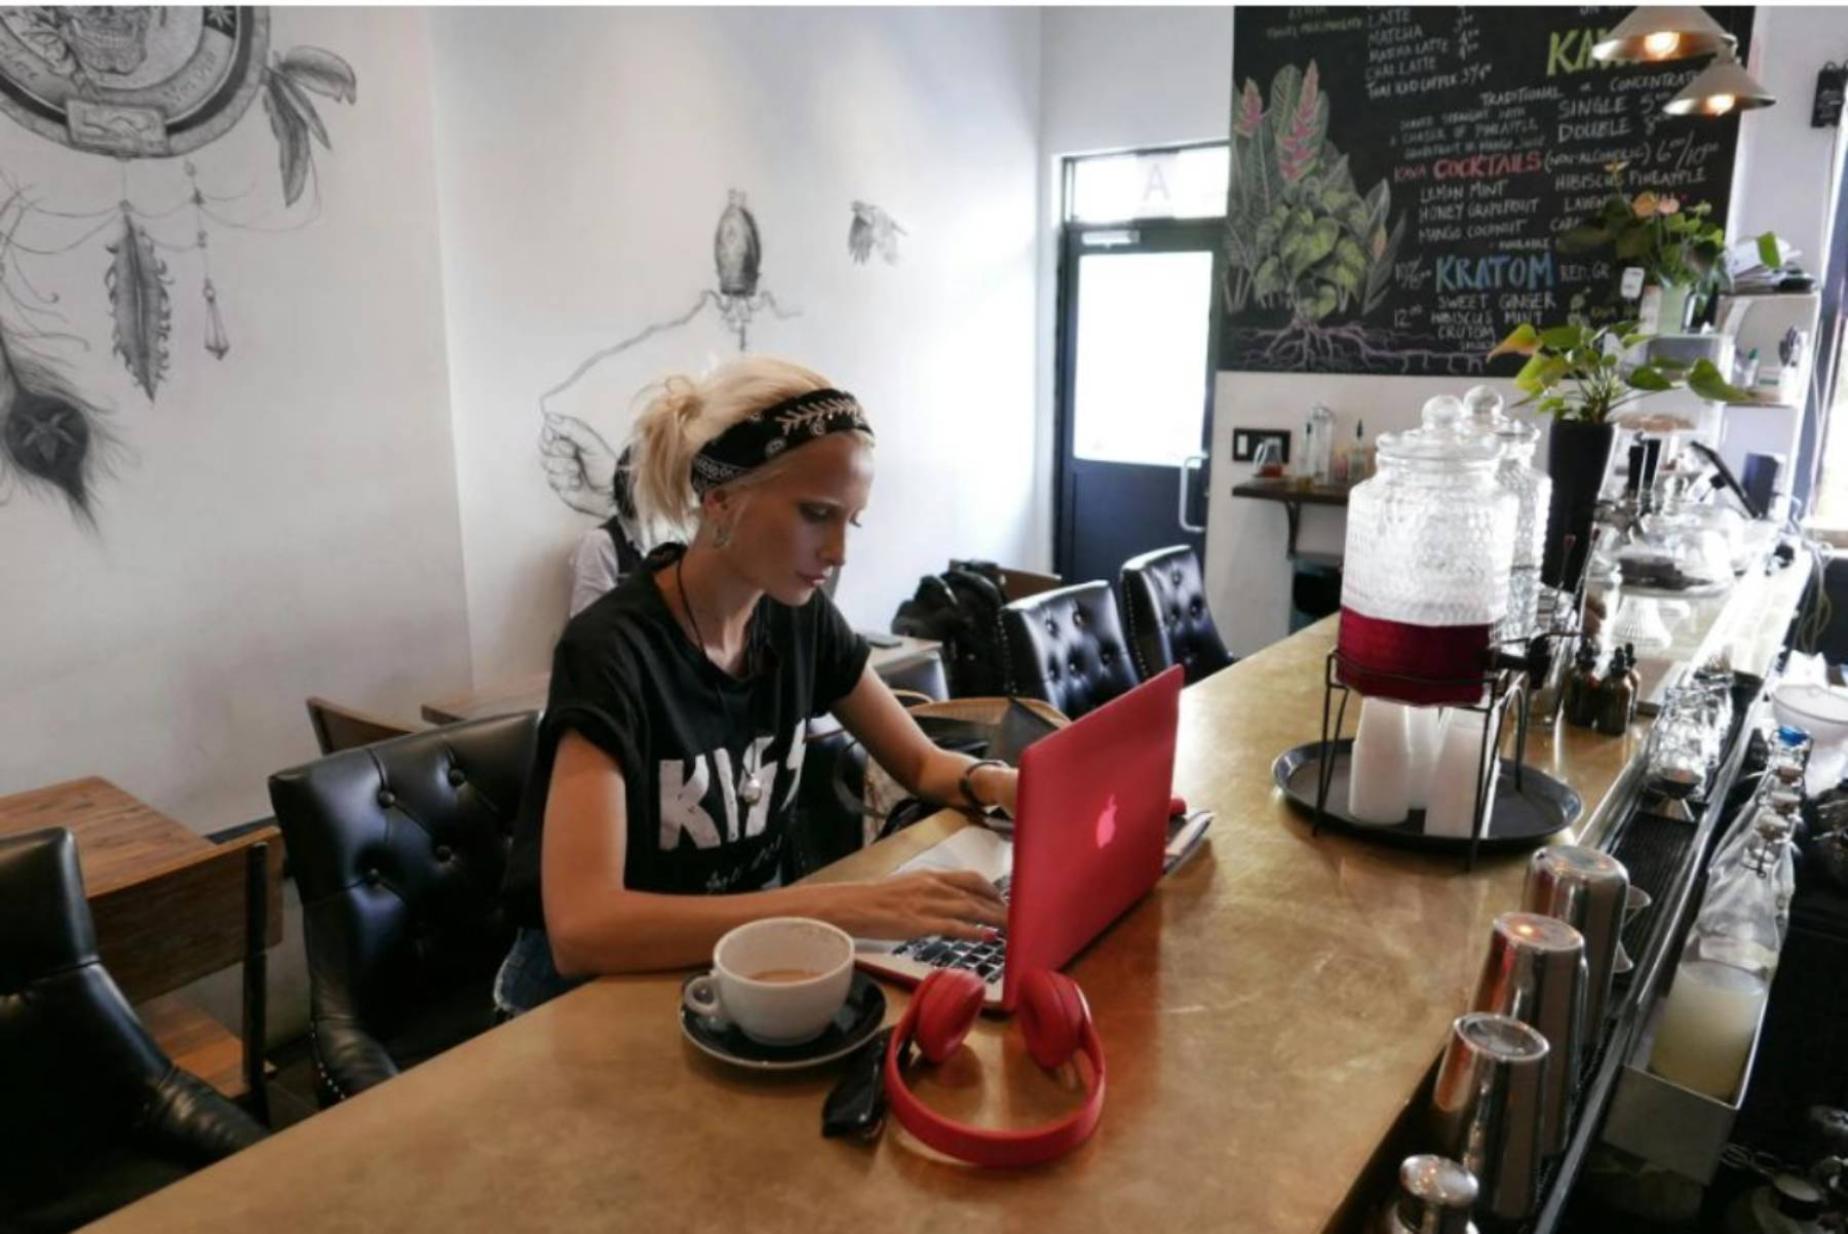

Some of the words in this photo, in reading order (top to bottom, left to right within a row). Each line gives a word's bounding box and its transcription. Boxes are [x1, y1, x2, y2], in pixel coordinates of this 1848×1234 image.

[1481, 86, 1564, 107] TRADITIONAL
[1558, 96, 1627, 120] SINGLE
[1558, 117, 1631, 143] DOUBLE
[1433, 151, 1542, 180] COCKTAILS
[1143, 163, 1171, 202] A
[1420, 184, 1464, 203] LEMON
[1470, 179, 1509, 197] MINT
[1554, 172, 1625, 191] HIBISCUS
[1629, 168, 1706, 187] PINEAPPLE
[1418, 202, 1463, 223] HONEY
[1435, 252, 1555, 293] KRATOM
[1438, 293, 1488, 310] SWEET
[1504, 310, 1544, 326] MINT
